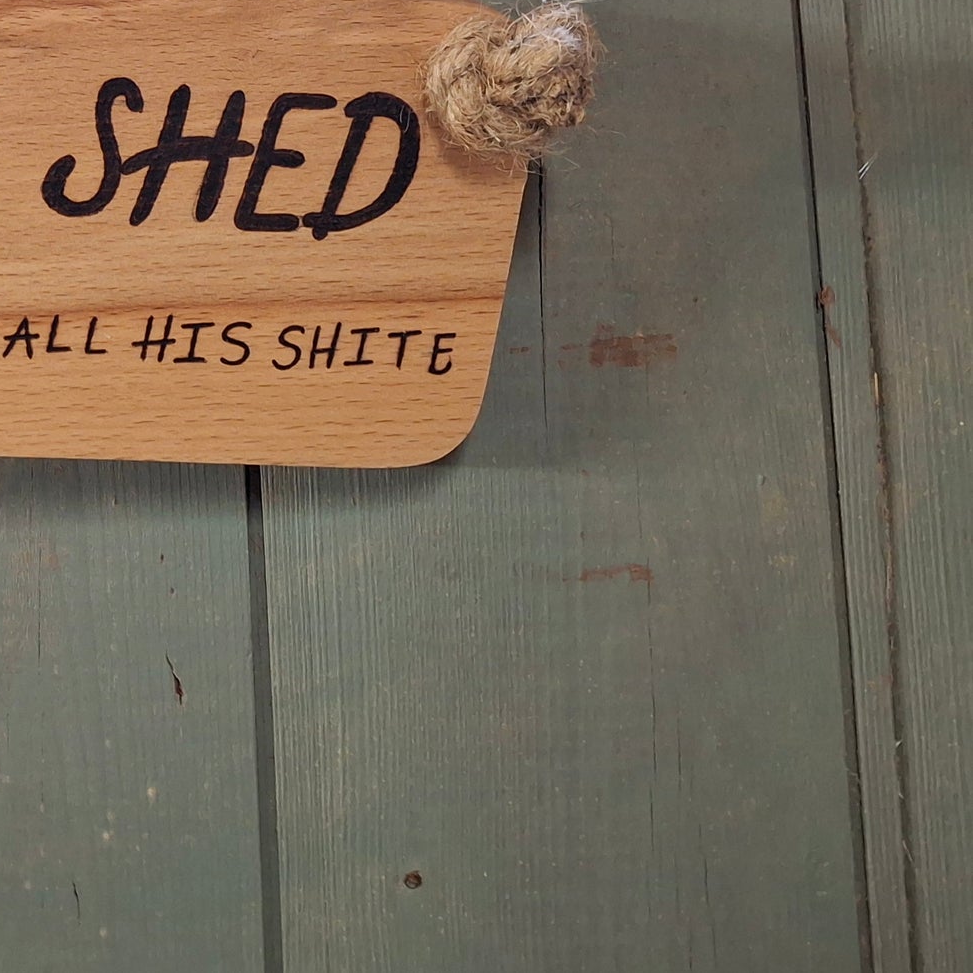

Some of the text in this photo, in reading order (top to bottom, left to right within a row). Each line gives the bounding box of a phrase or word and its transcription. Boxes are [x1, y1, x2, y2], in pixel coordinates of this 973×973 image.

[40, 76, 422, 241] SHED
[1, 313, 108, 360] ALL
[131, 313, 253, 366] HIS
[271, 324, 457, 376] SHITE
